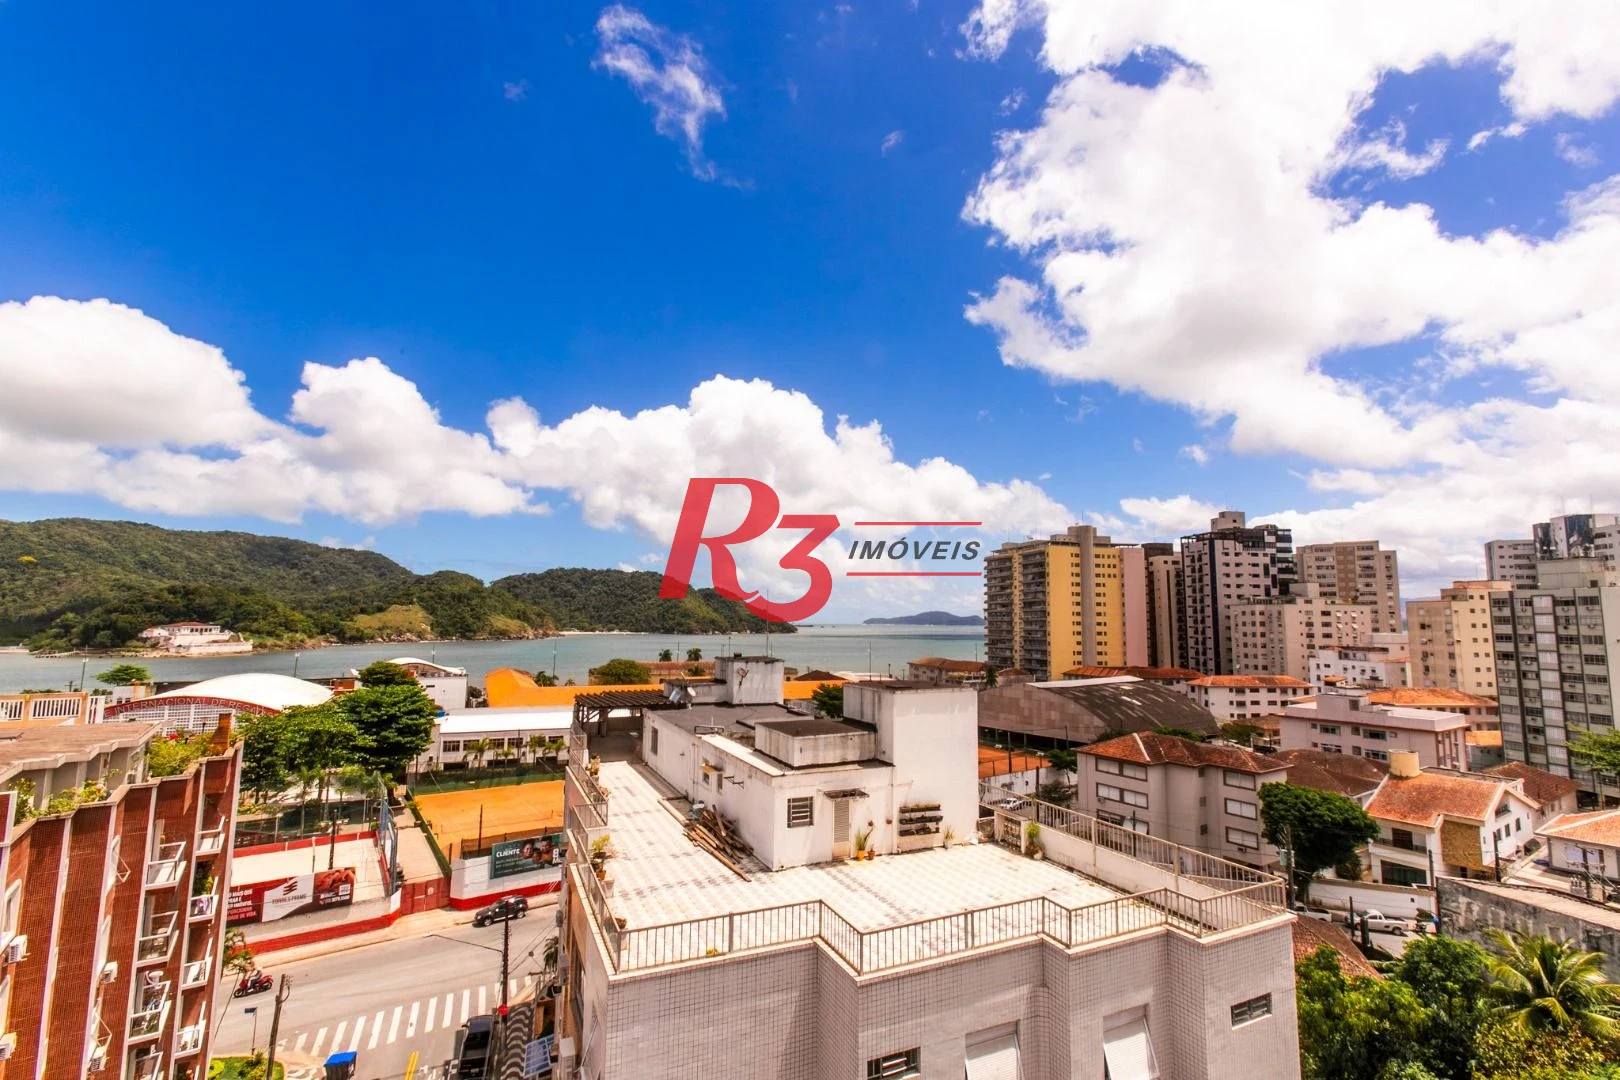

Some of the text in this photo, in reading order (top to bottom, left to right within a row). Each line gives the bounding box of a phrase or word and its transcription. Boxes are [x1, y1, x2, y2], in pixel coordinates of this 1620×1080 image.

[115, 697, 206, 713] INTERNACIONAL
[211, 698, 226, 706] DE
[496, 848, 520, 858] CLIENTE
